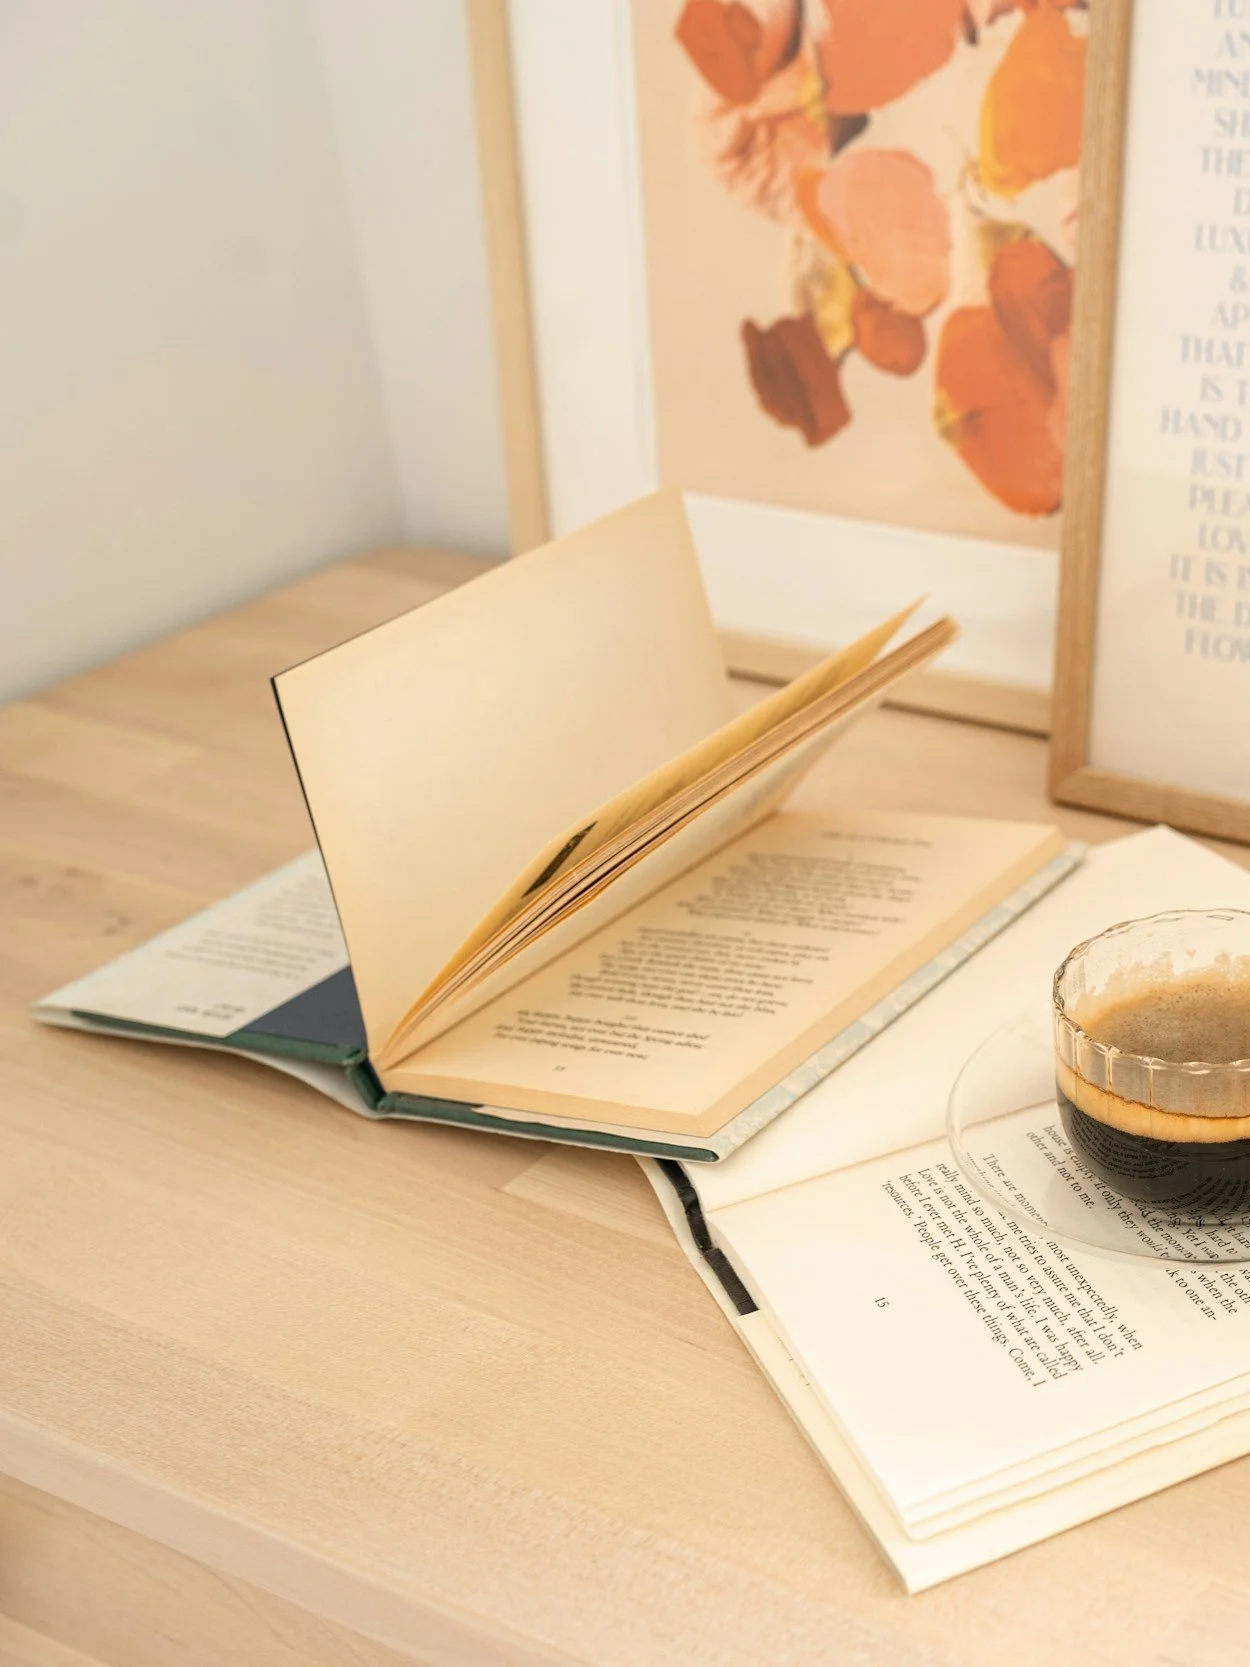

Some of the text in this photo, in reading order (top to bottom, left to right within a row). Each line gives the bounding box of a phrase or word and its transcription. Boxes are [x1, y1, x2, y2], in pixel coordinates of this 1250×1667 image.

[1201, 147, 1249, 175] THE
[1230, 265, 1249, 292] &
[1180, 335, 1246, 367] THAT
[1201, 377, 1224, 400] IS
[1162, 408, 1242, 441] HAND
[1192, 448, 1245, 478] JUST
[1170, 554, 1198, 582] IT
[1204, 561, 1229, 586] IS
[1170, 590, 1224, 622] THE
[936, 1163, 958, 1183] really
[954, 1184, 979, 1206] mind
[971, 1206, 985, 1216] so
[980, 1217, 1007, 1246] much,
[1003, 1246, 1021, 1262] not
[1015, 1263, 1029, 1274] so
[1026, 1275, 1047, 1295] very
[1042, 1296, 1071, 1326] much,
[1066, 1327, 1090, 1348] after
[983, 1154, 1006, 1178] There
[1002, 1180, 1017, 1192] are
[1046, 1241, 1069, 1263] most
[1066, 1264, 1118, 1323] unexpectedly,
[1117, 1324, 1142, 1350] when
[899, 1173, 923, 1197] before
[922, 1203, 942, 1220] ever
[936, 1221, 955, 1239] met
[950, 1238, 967, 1252] H.
[972, 1271, 1001, 1299] plenty
[996, 1301, 1016, 1311] of
[1006, 1312, 1029, 1336] what
[1023, 1336, 1041, 1350] are
[1036, 1352, 1068, 1380] called
[913, 1221, 940, 1251] People
[932, 1252, 953, 1267] get
[947, 1268, 968, 1288] over
[963, 1289, 986, 1314] these
[982, 1315, 1009, 1347] things.
[917, 1168, 938, 1187] Love
[933, 1187, 945, 1195] is
[939, 1195, 957, 1210] not
[951, 1209, 968, 1224] the
[964, 1225, 990, 1252] whole
[985, 1253, 1003, 1264] of
[1041, 1324, 1059, 1343] was
[1055, 1341, 1084, 1371] happy
[1006, 1221, 1023, 1235] me
[1018, 1235, 1039, 1255] tries
[1034, 1255, 1047, 1266] to
[1042, 1266, 1069, 1292] assure
[1064, 1293, 1081, 1308] me
[1077, 1307, 1098, 1327] that
[874, 1297, 890, 1308] 15
